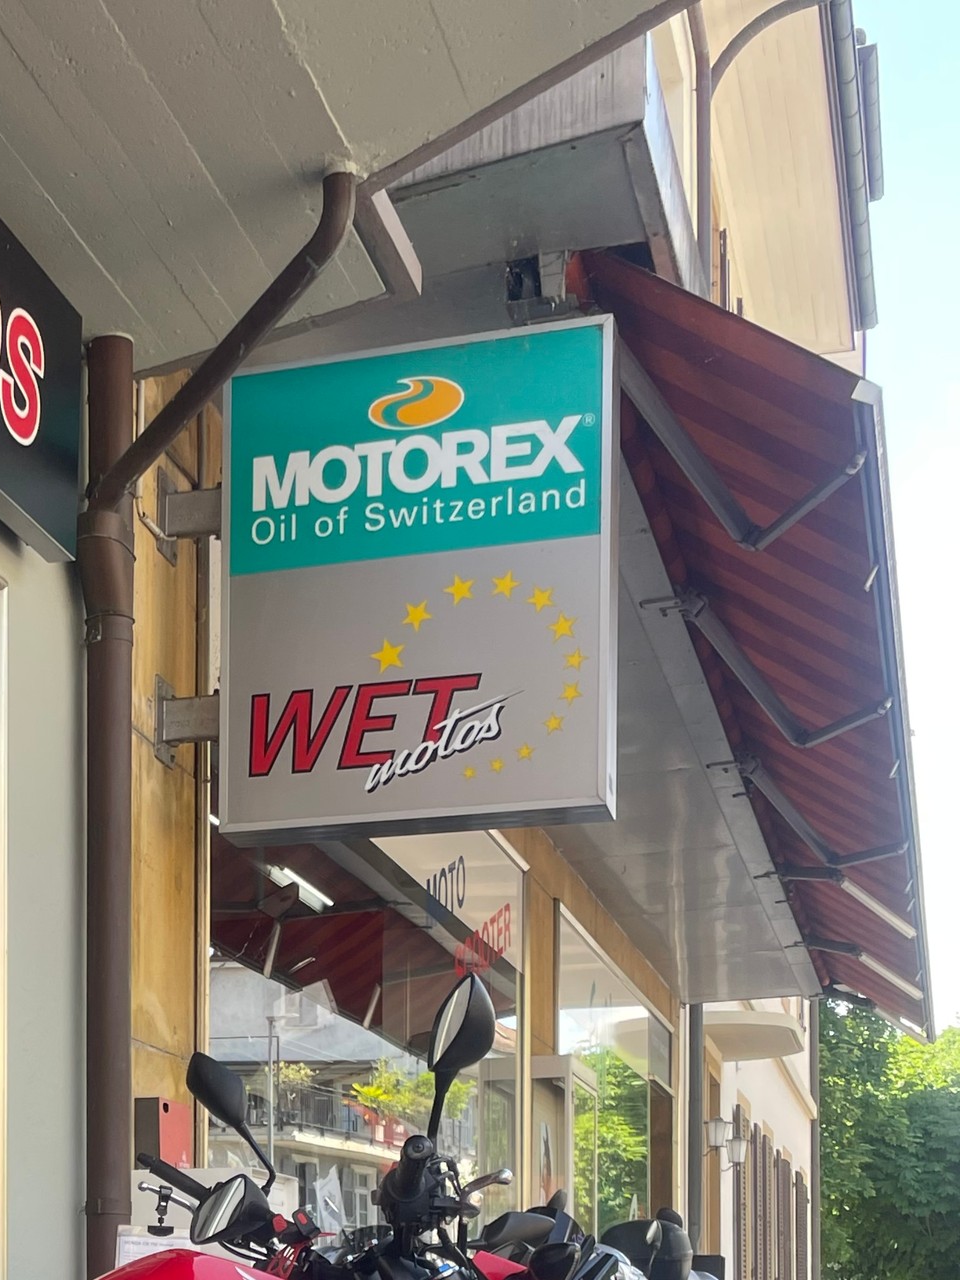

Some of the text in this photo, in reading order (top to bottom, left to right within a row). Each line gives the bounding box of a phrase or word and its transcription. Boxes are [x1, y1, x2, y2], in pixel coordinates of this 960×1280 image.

[251, 478, 586, 545] Oil of Switzerland
[252, 414, 585, 512] MOTOREX
[248, 672, 482, 778] WET
[364, 690, 520, 793] motos
